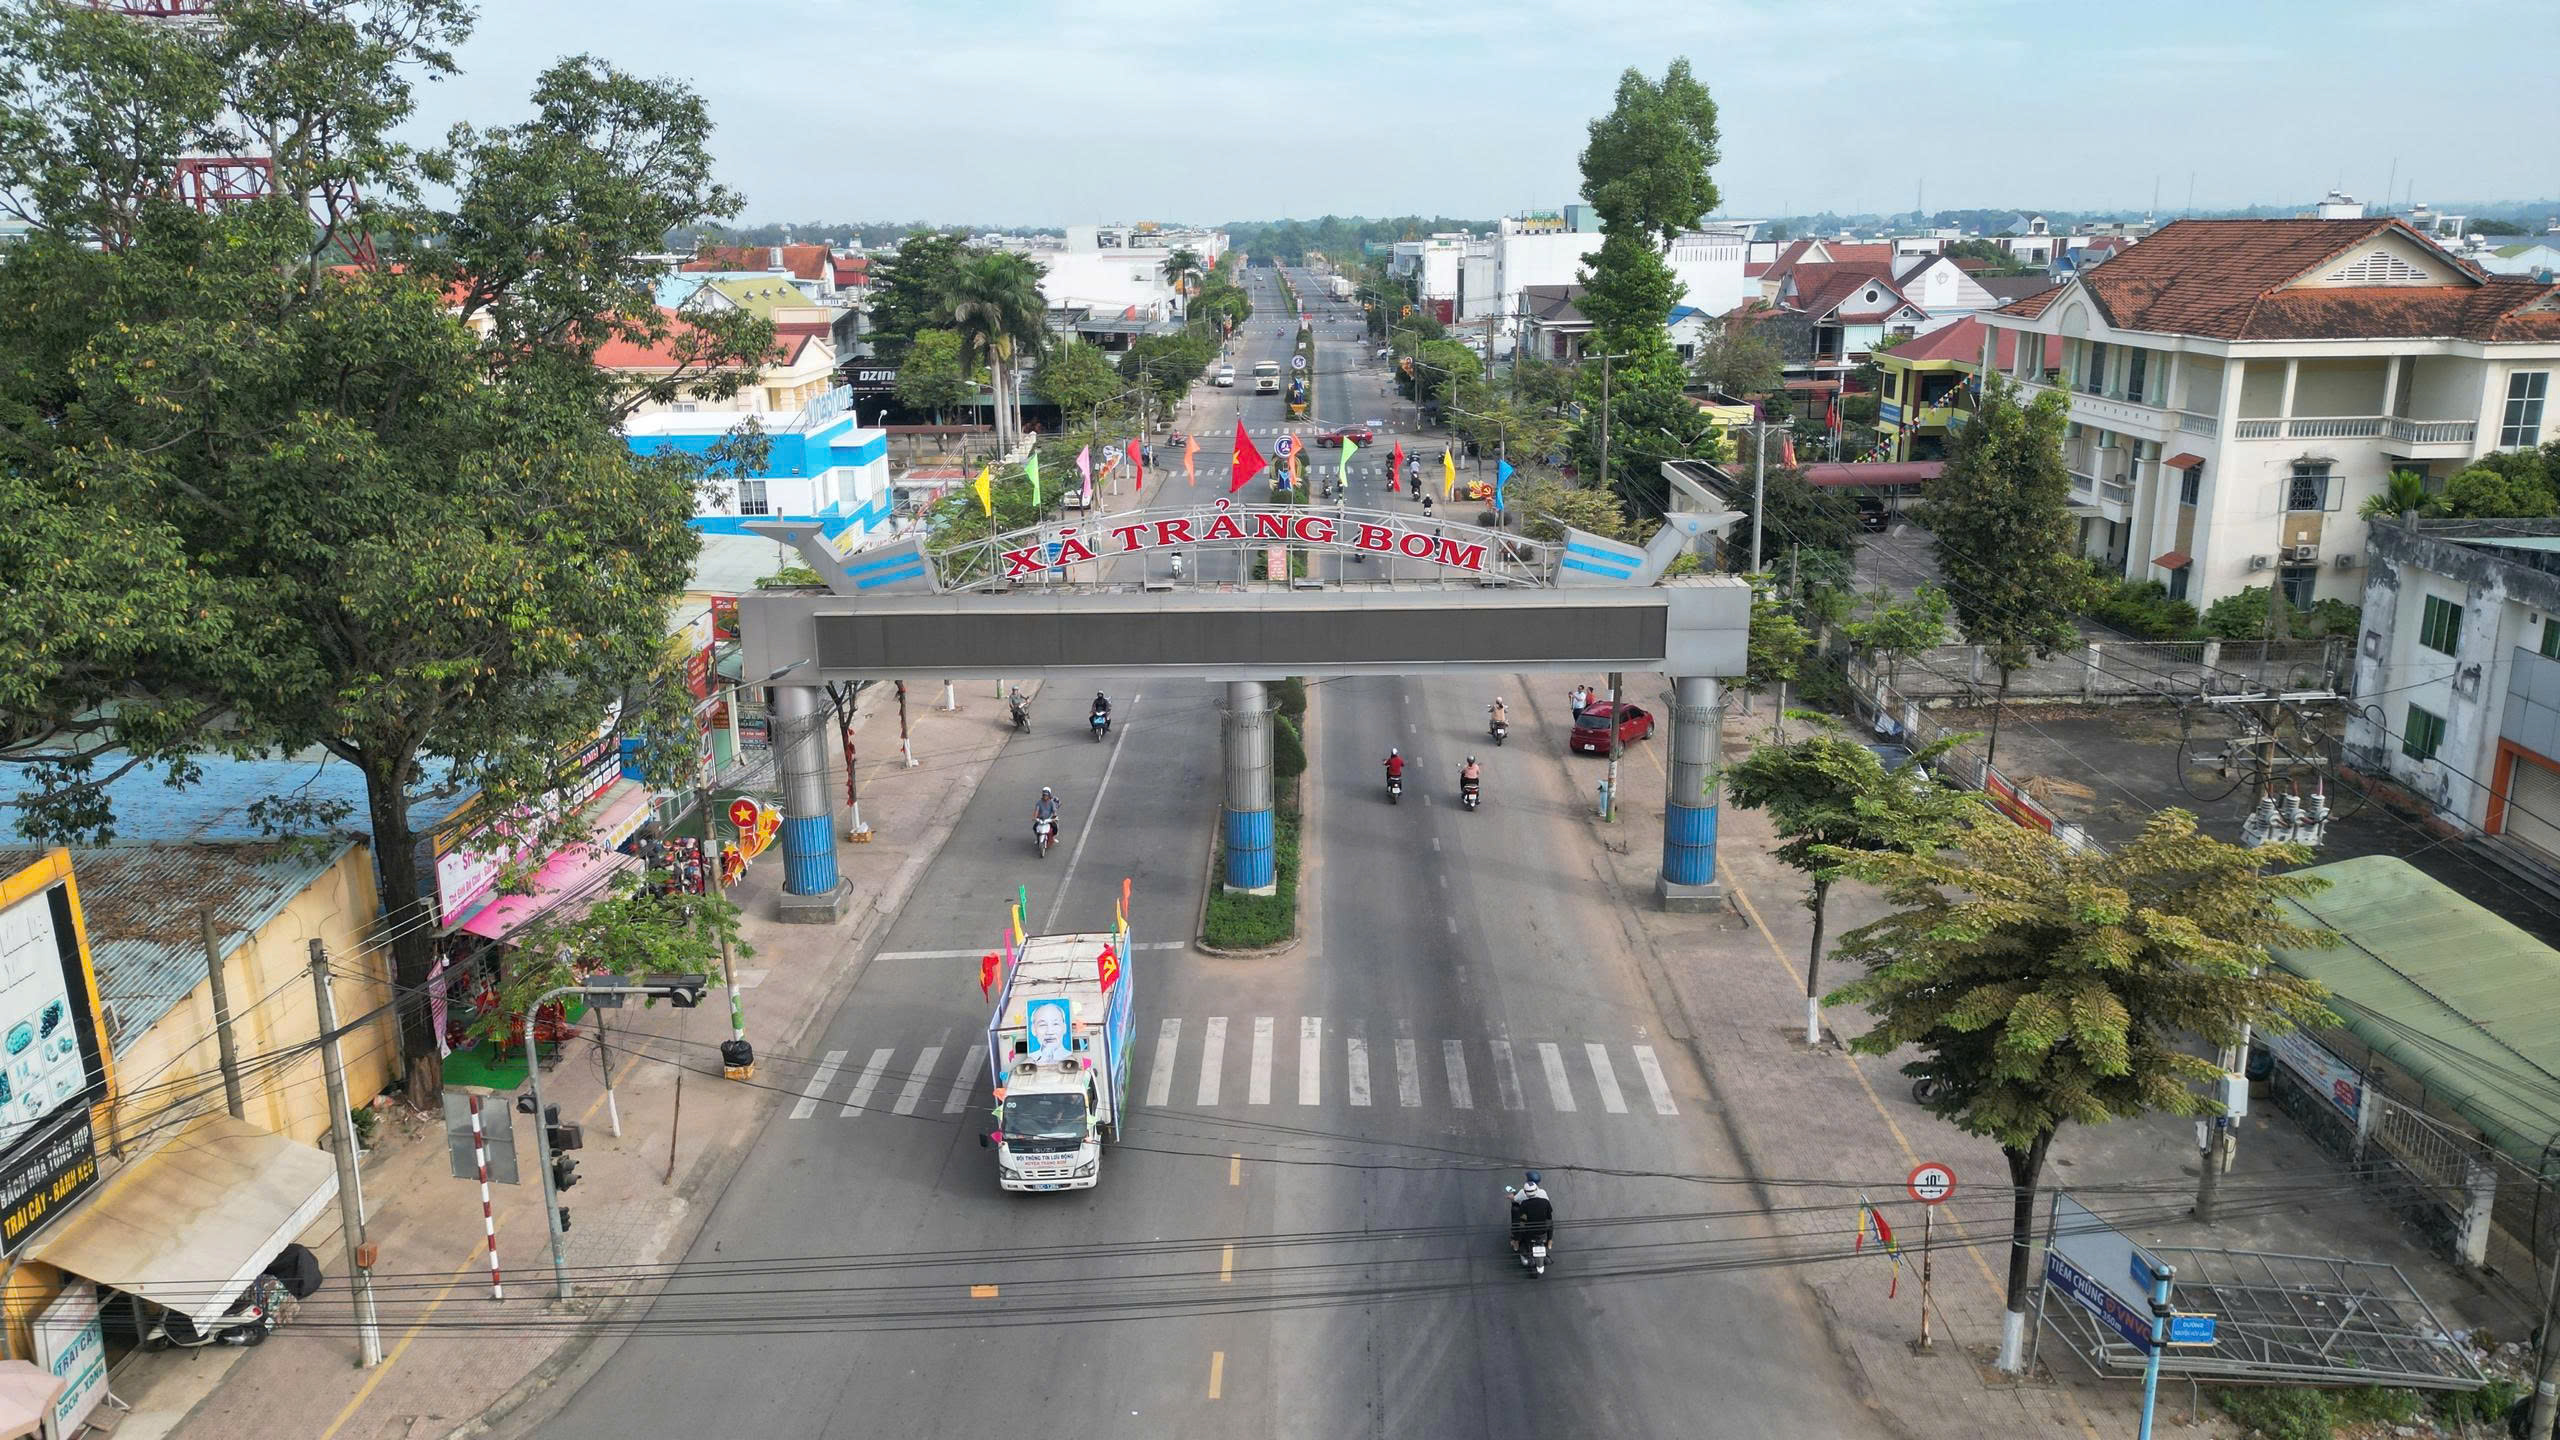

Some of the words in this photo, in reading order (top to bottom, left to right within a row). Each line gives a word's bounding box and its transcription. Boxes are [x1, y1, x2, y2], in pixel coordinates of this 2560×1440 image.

[1000, 526, 1097, 580] XÃ
[1110, 497, 1339, 552] TRẢNG
[1354, 521, 1489, 571] BOM
[4, 1205, 28, 1240] TRÁI
[28, 1191, 47, 1221] CÂY
[52, 1169, 77, 1202] BÁNH
[2051, 1256, 2072, 1282] TIÊM
[2073, 1273, 2104, 1306] CHỦNG
